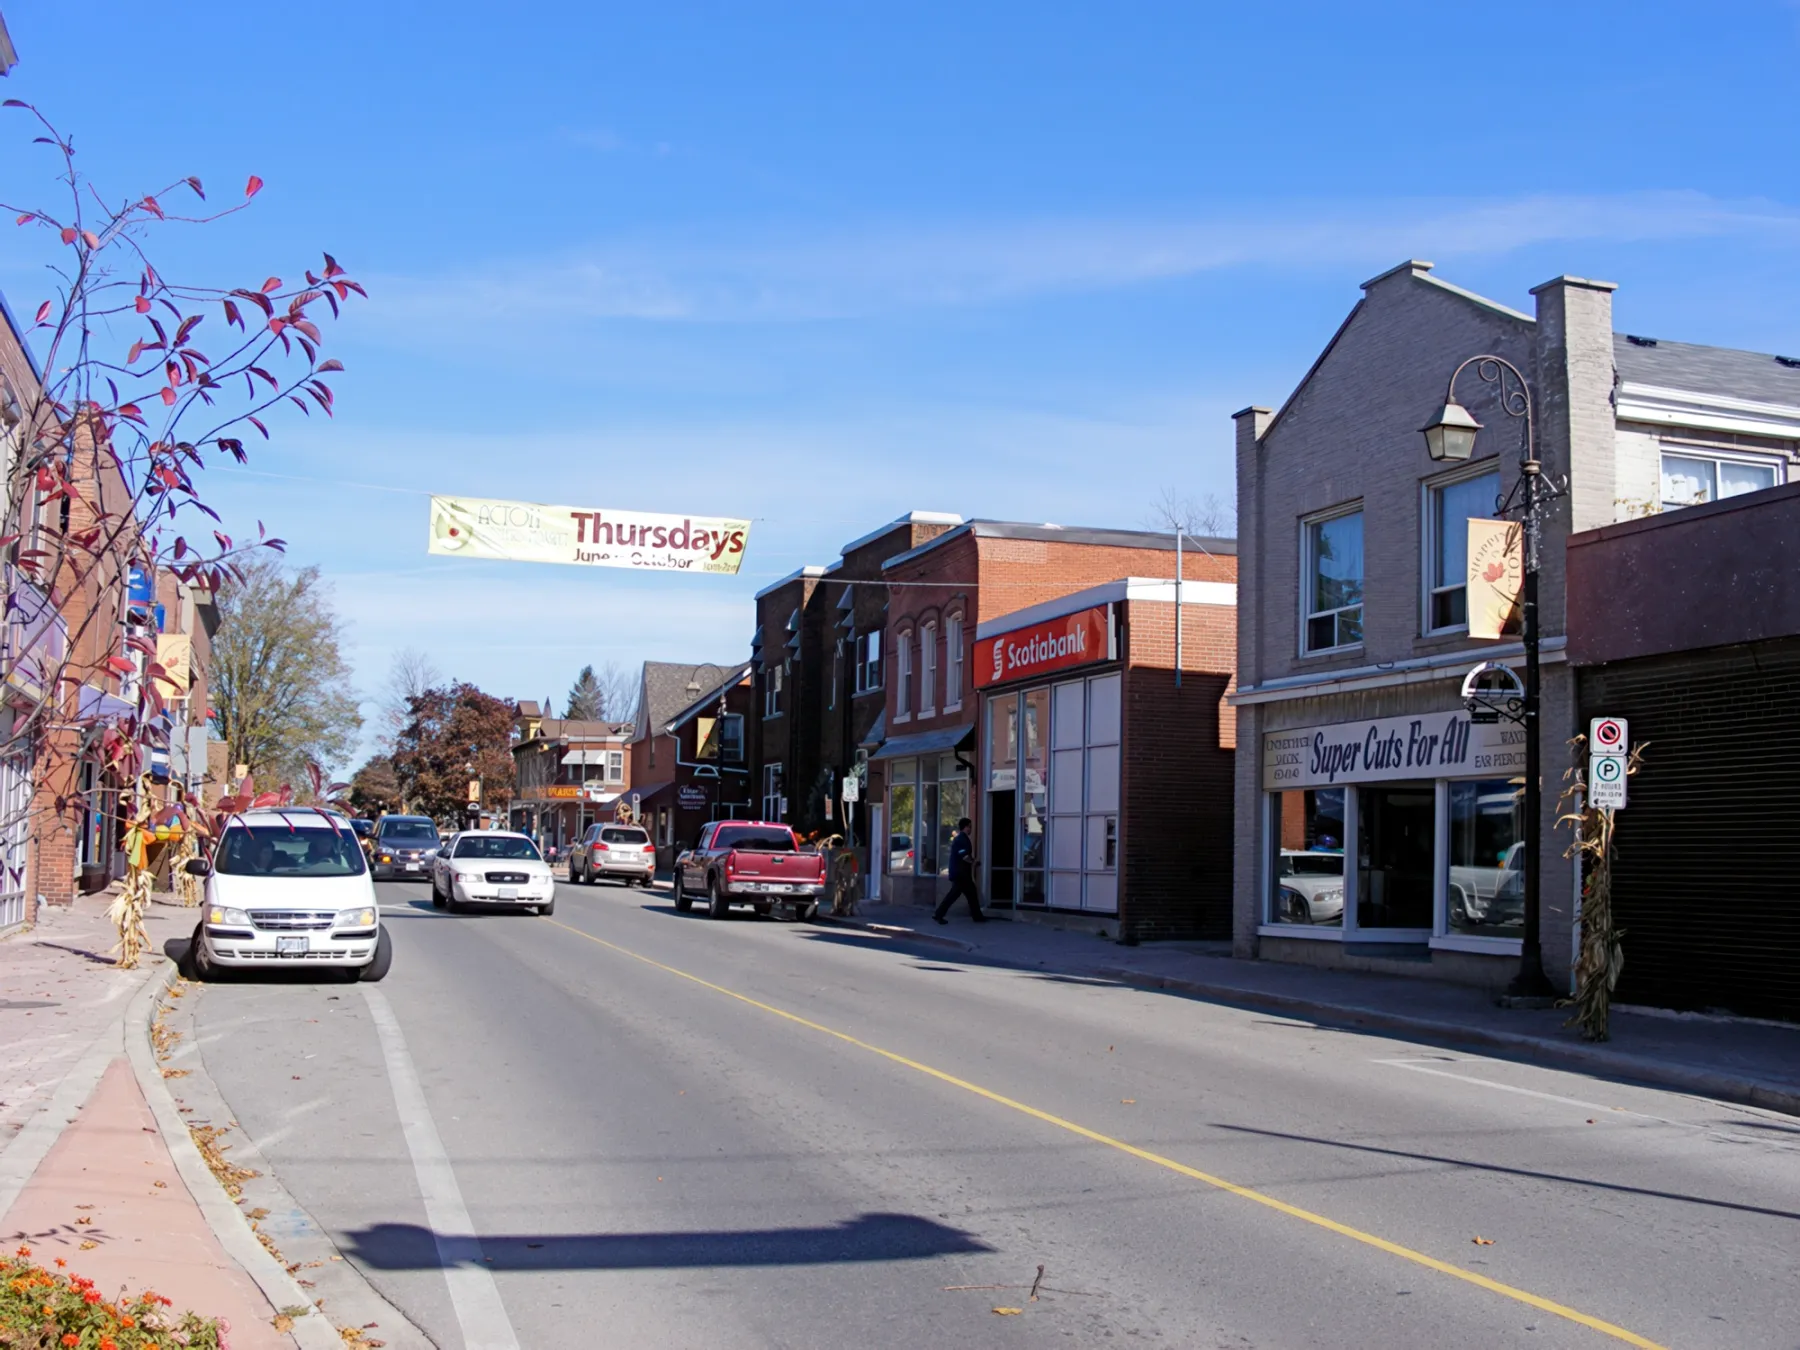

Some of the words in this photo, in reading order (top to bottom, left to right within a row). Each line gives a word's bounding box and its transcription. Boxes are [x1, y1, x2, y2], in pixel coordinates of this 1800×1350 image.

[570, 511, 744, 561] Thursdays
[1008, 623, 1086, 670] Scotiabank
[1311, 731, 1361, 782] Super
[1364, 725, 1402, 770] Cuts
[1406, 720, 1438, 767] For
[1440, 715, 1470, 765] All
[1475, 755, 1492, 768] EAR
[1493, 752, 1526, 766] PIERCI
